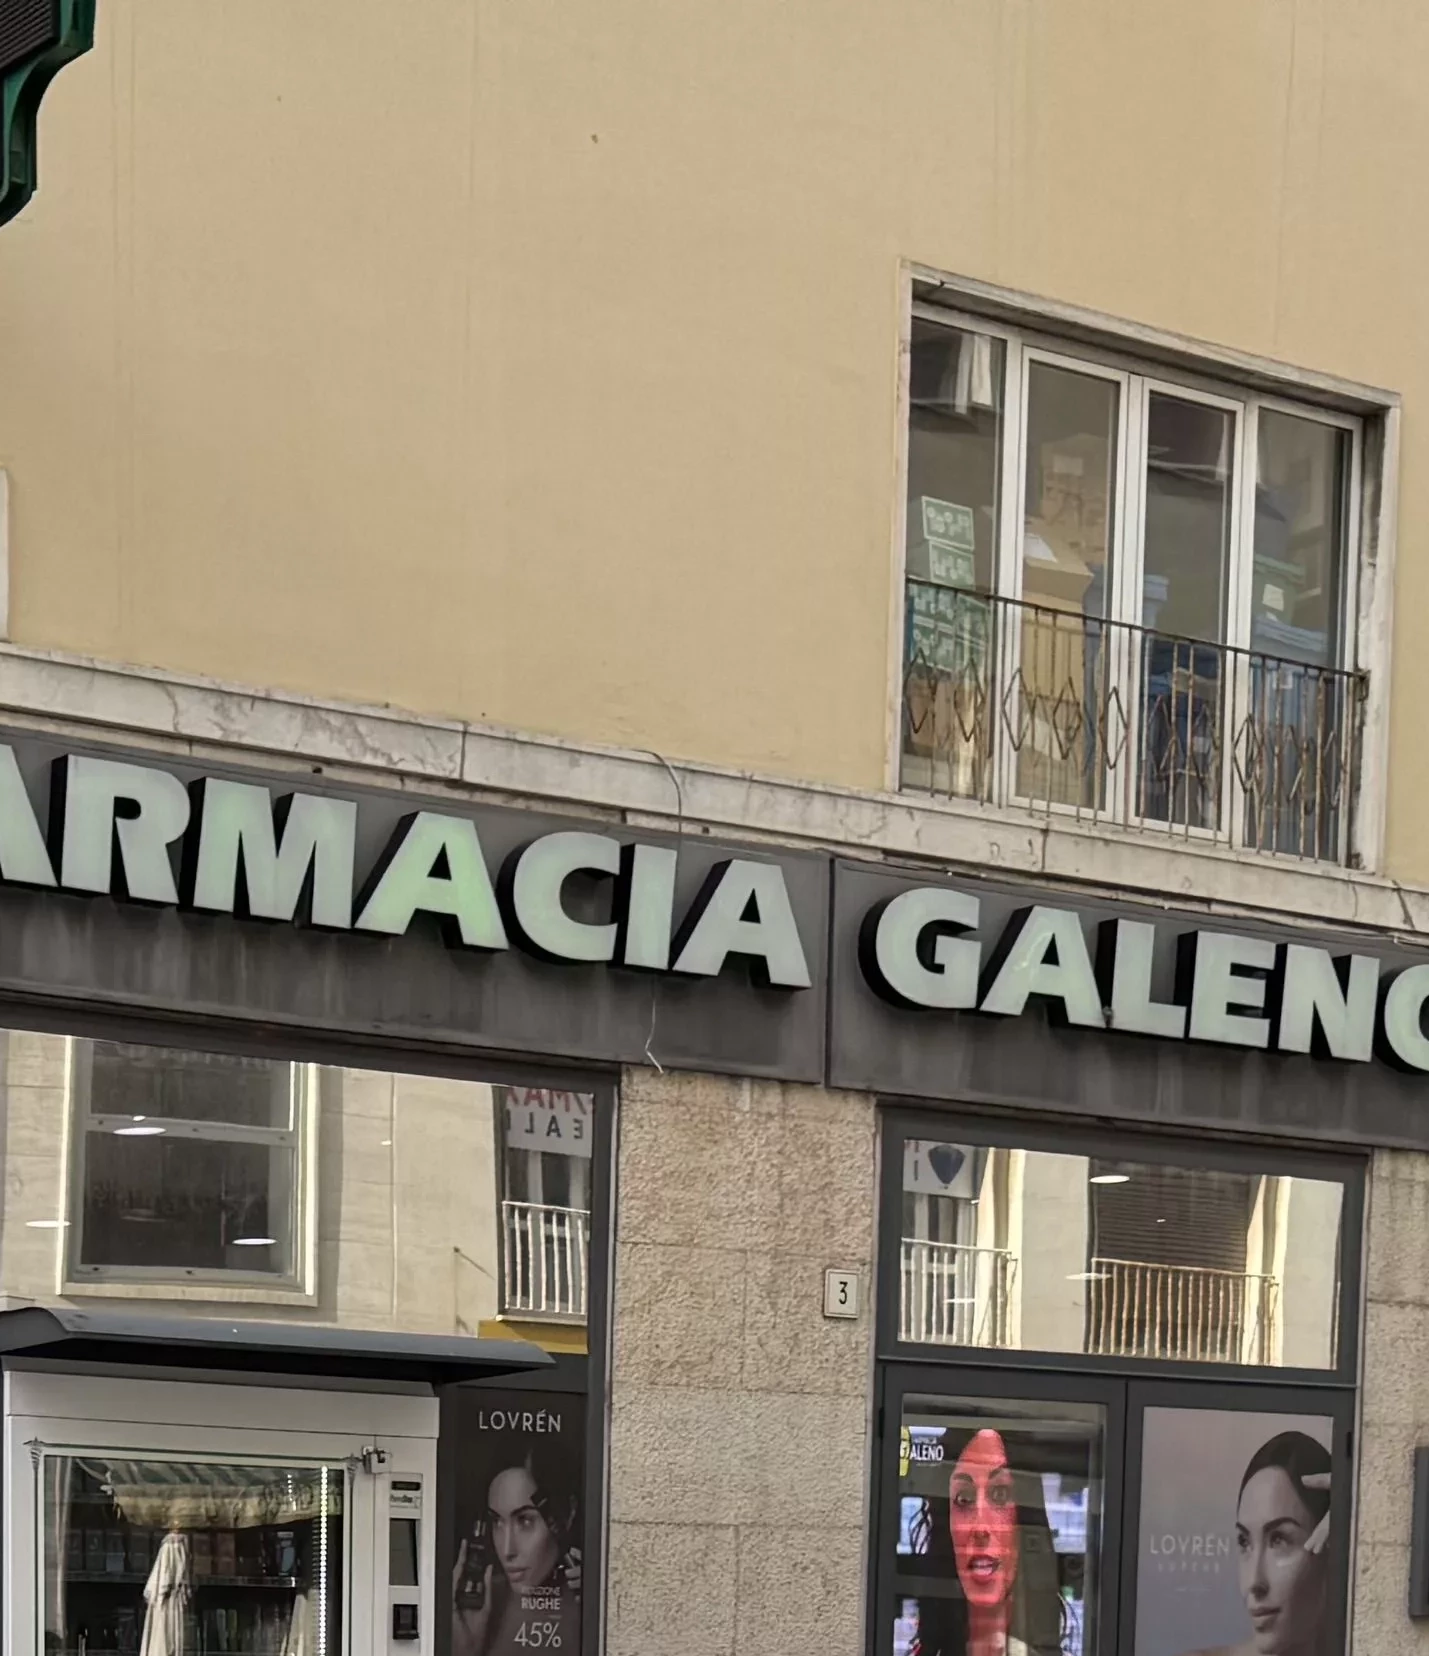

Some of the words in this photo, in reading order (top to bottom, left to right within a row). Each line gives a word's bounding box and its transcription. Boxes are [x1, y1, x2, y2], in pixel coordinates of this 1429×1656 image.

[838, 1281, 848, 1305] 3
[479, 1409, 561, 1433] LOVRÉN
[521, 1597, 561, 1611] RUGHE
[513, 1621, 562, 1648] 45%
